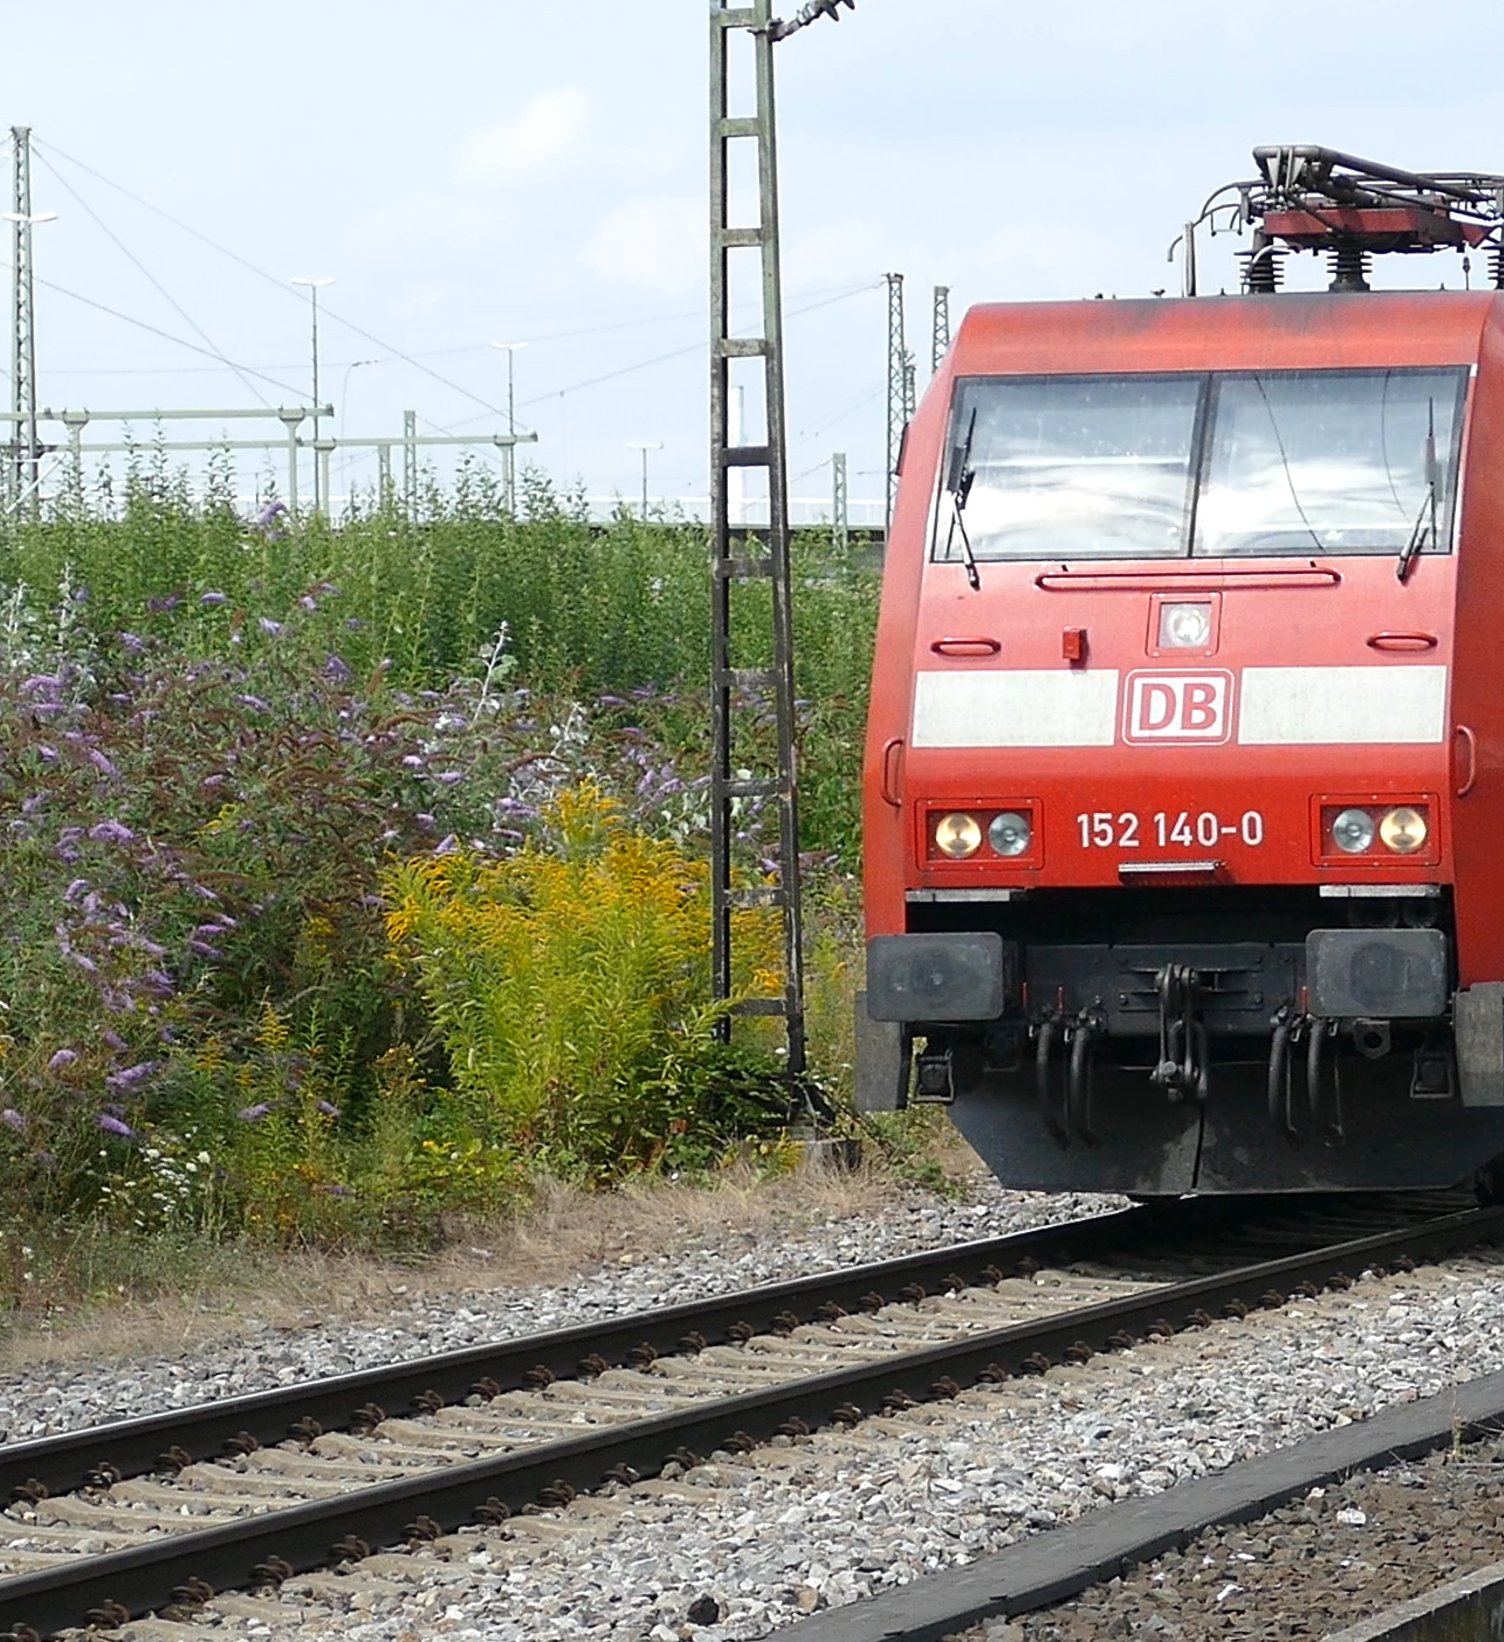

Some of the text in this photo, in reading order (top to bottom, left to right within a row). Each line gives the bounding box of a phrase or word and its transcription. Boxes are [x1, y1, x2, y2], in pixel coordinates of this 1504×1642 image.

[1139, 682, 1217, 731] DB
[1077, 811, 1263, 848] 152 140-0
